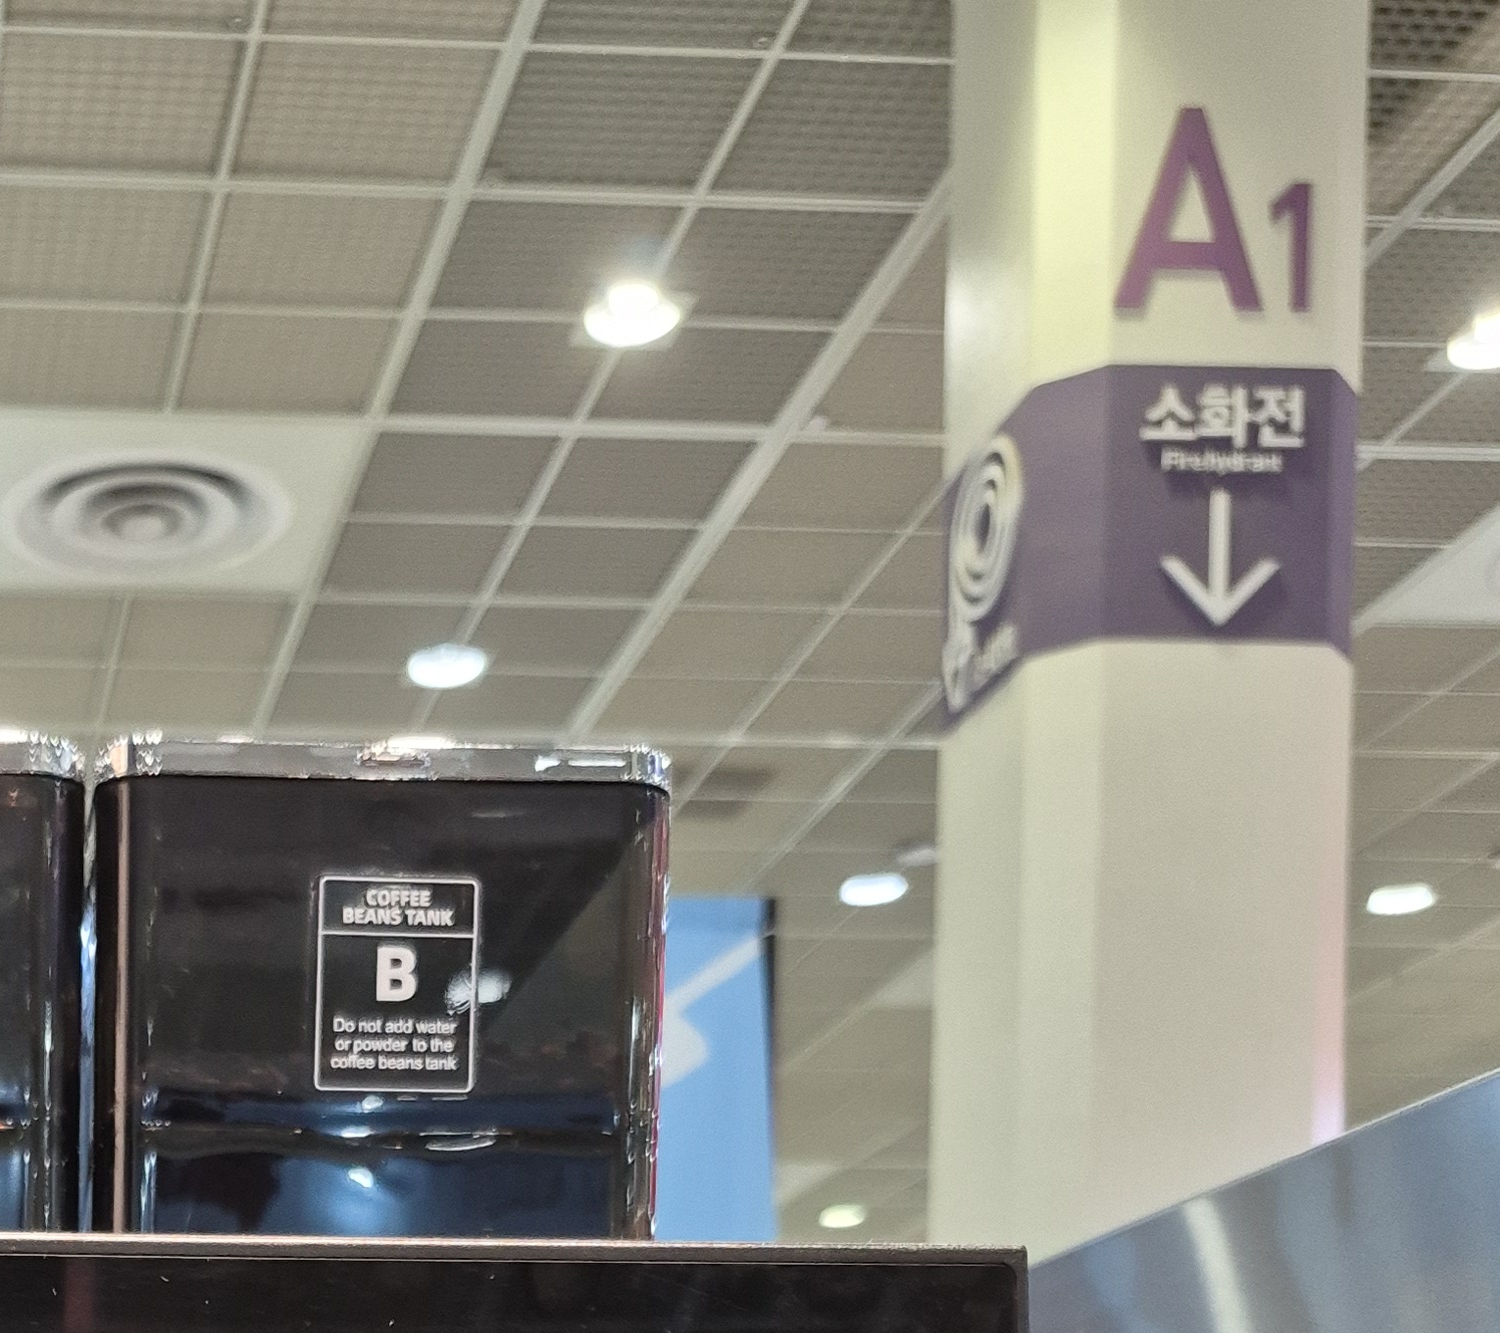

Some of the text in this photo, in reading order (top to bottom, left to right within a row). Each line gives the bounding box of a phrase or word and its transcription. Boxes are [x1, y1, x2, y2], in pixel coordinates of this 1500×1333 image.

[1139, 382, 1306, 449] 소화전
[366, 887, 432, 907] COFFEE
[342, 907, 454, 926] BEANS TANK
[376, 945, 417, 1002] B
[333, 1017, 457, 1035] Do not add water
[335, 1036, 454, 1054] or powder to the
[330, 1054, 458, 1071] coffee beans tank
